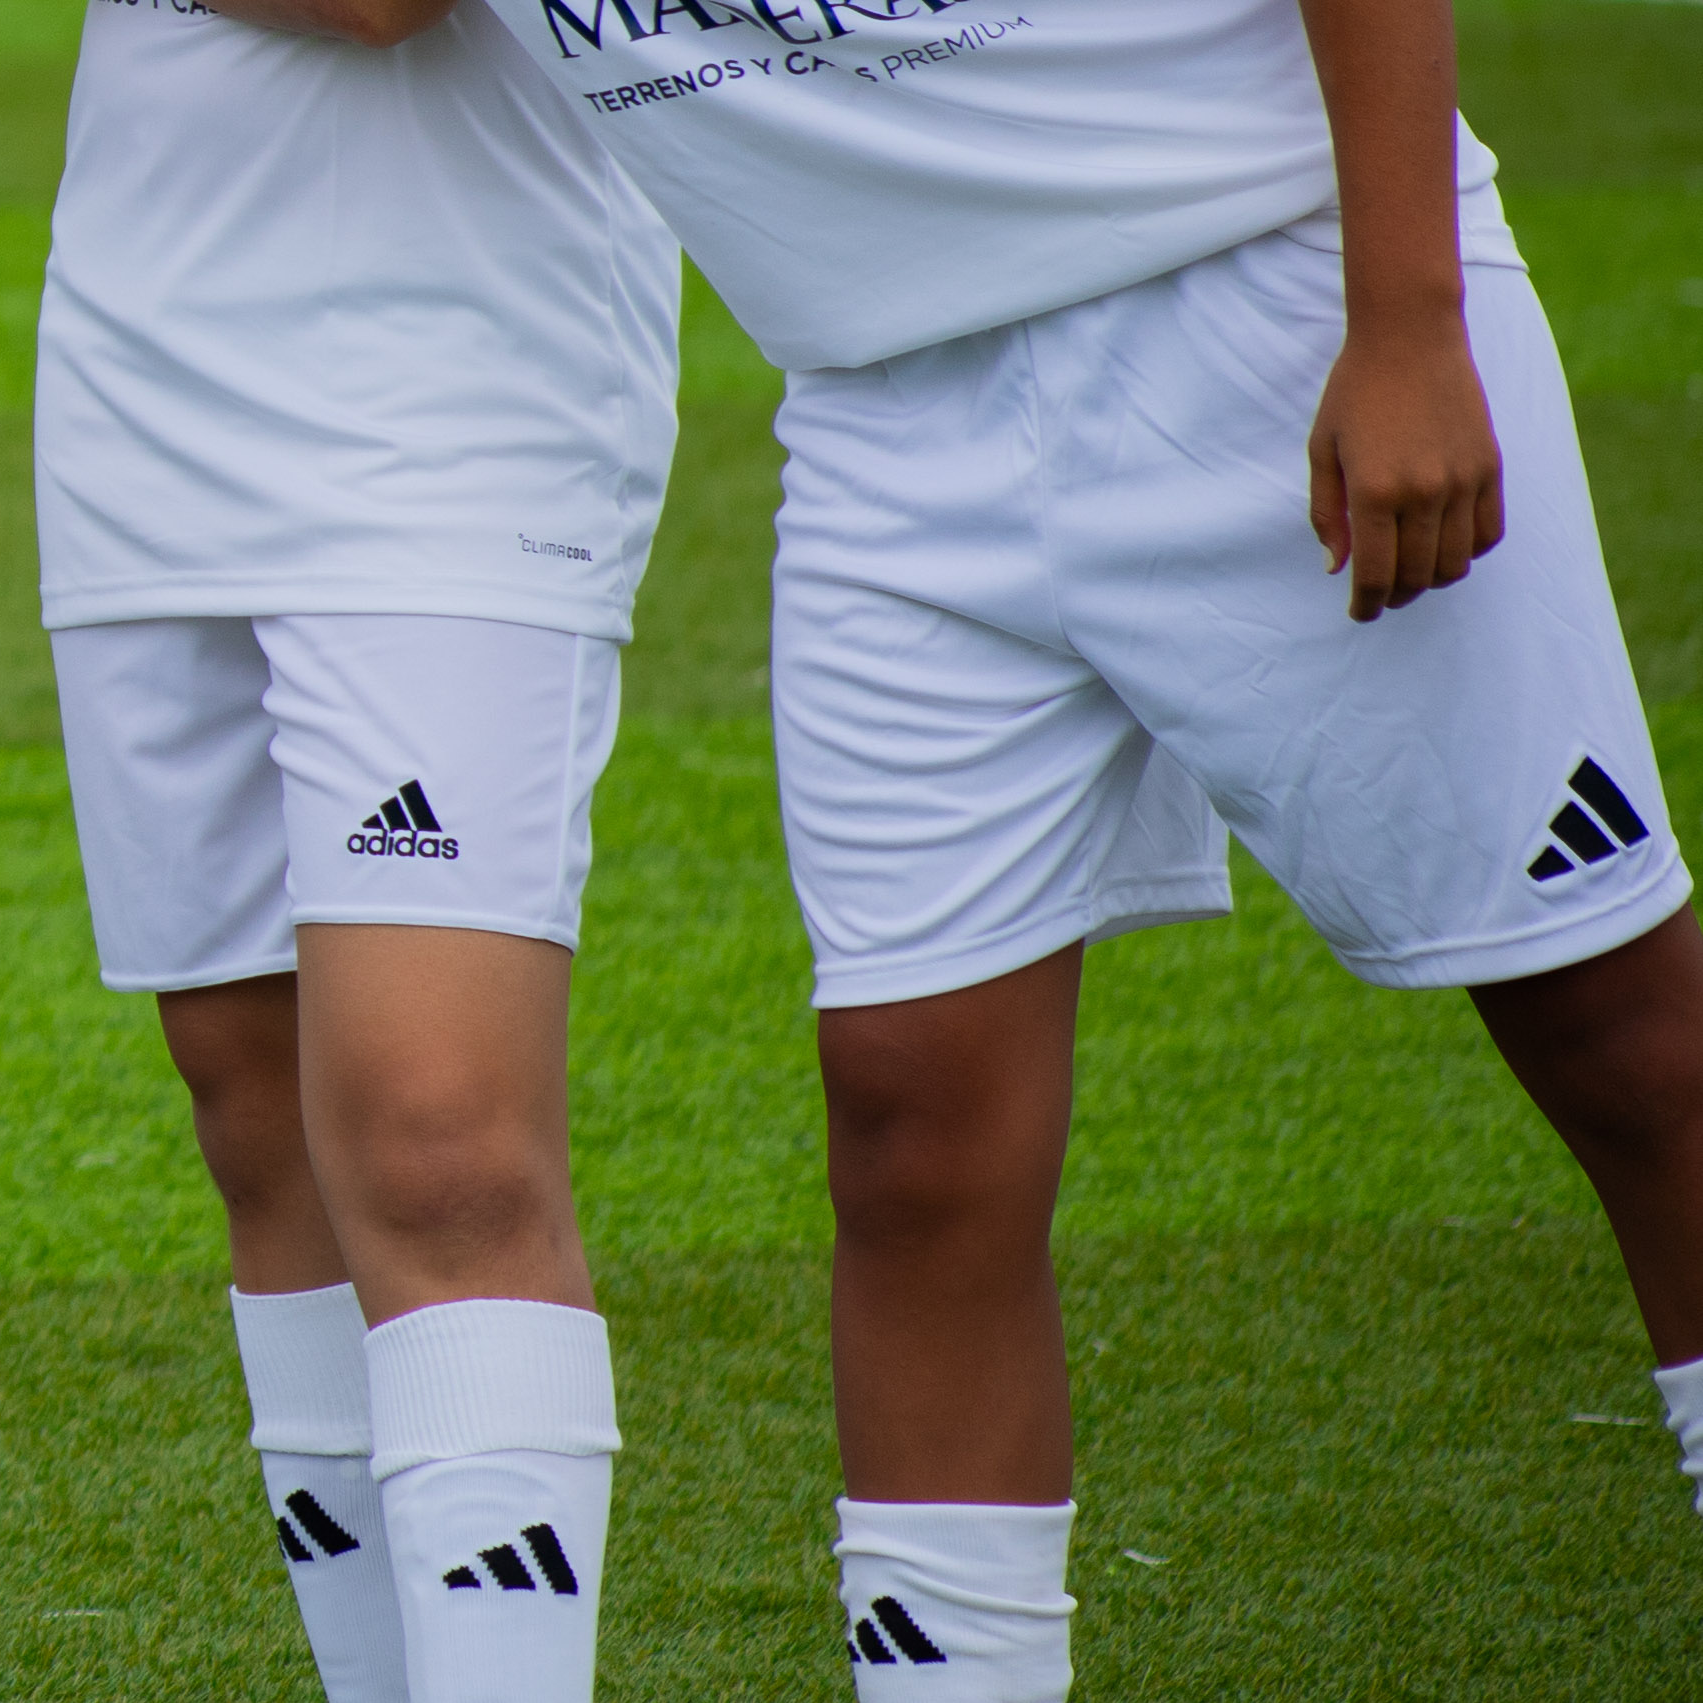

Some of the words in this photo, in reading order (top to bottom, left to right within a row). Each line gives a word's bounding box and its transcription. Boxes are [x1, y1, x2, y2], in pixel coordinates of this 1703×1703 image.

[583, 59, 745, 114] TERRENOS
[750, 58, 772, 76] Y
[881, 16, 1033, 80] PREMIUM
[347, 828, 459, 860] adidas
